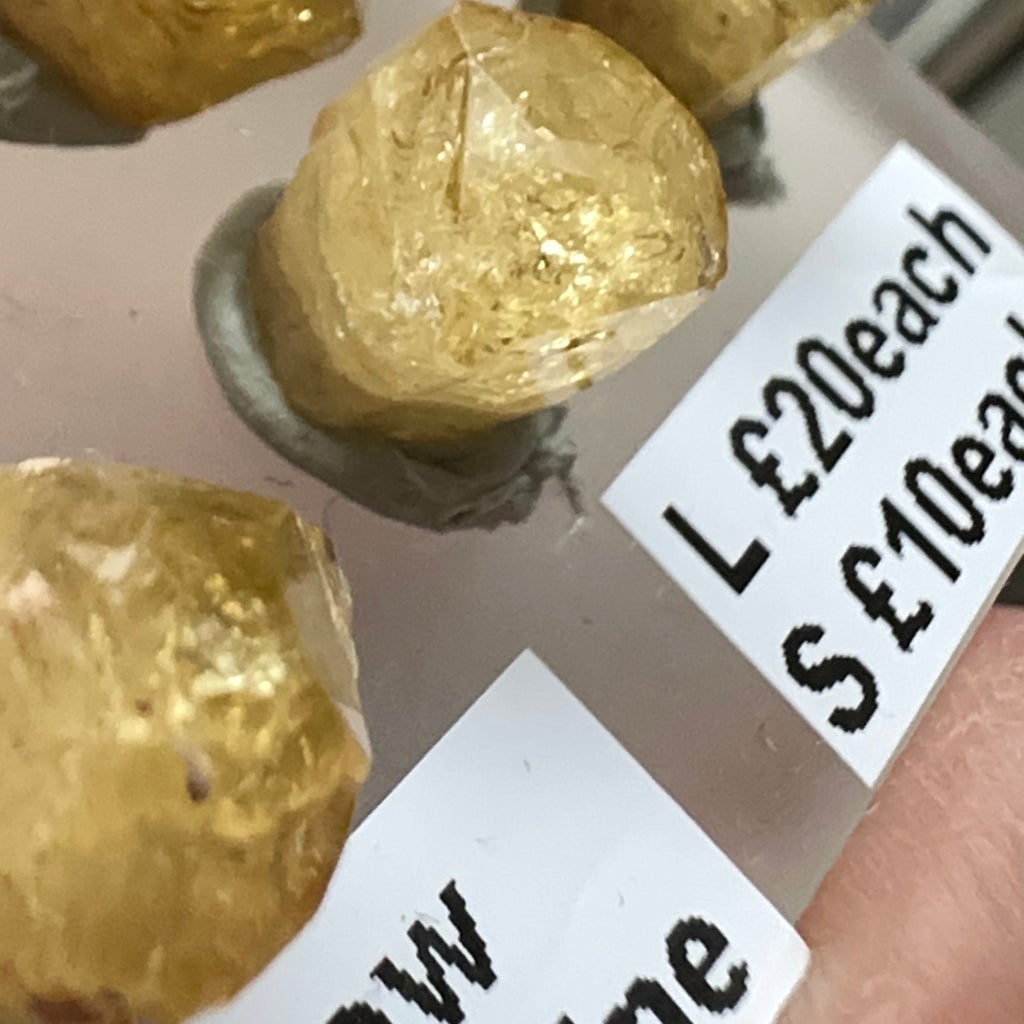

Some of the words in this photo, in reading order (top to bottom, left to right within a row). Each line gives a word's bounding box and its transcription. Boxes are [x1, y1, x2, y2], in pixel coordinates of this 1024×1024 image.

[662, 505, 771, 596] L
[729, 207, 992, 517] £20each
[781, 623, 880, 735] S
[839, 313, 1024, 653] £10ea
